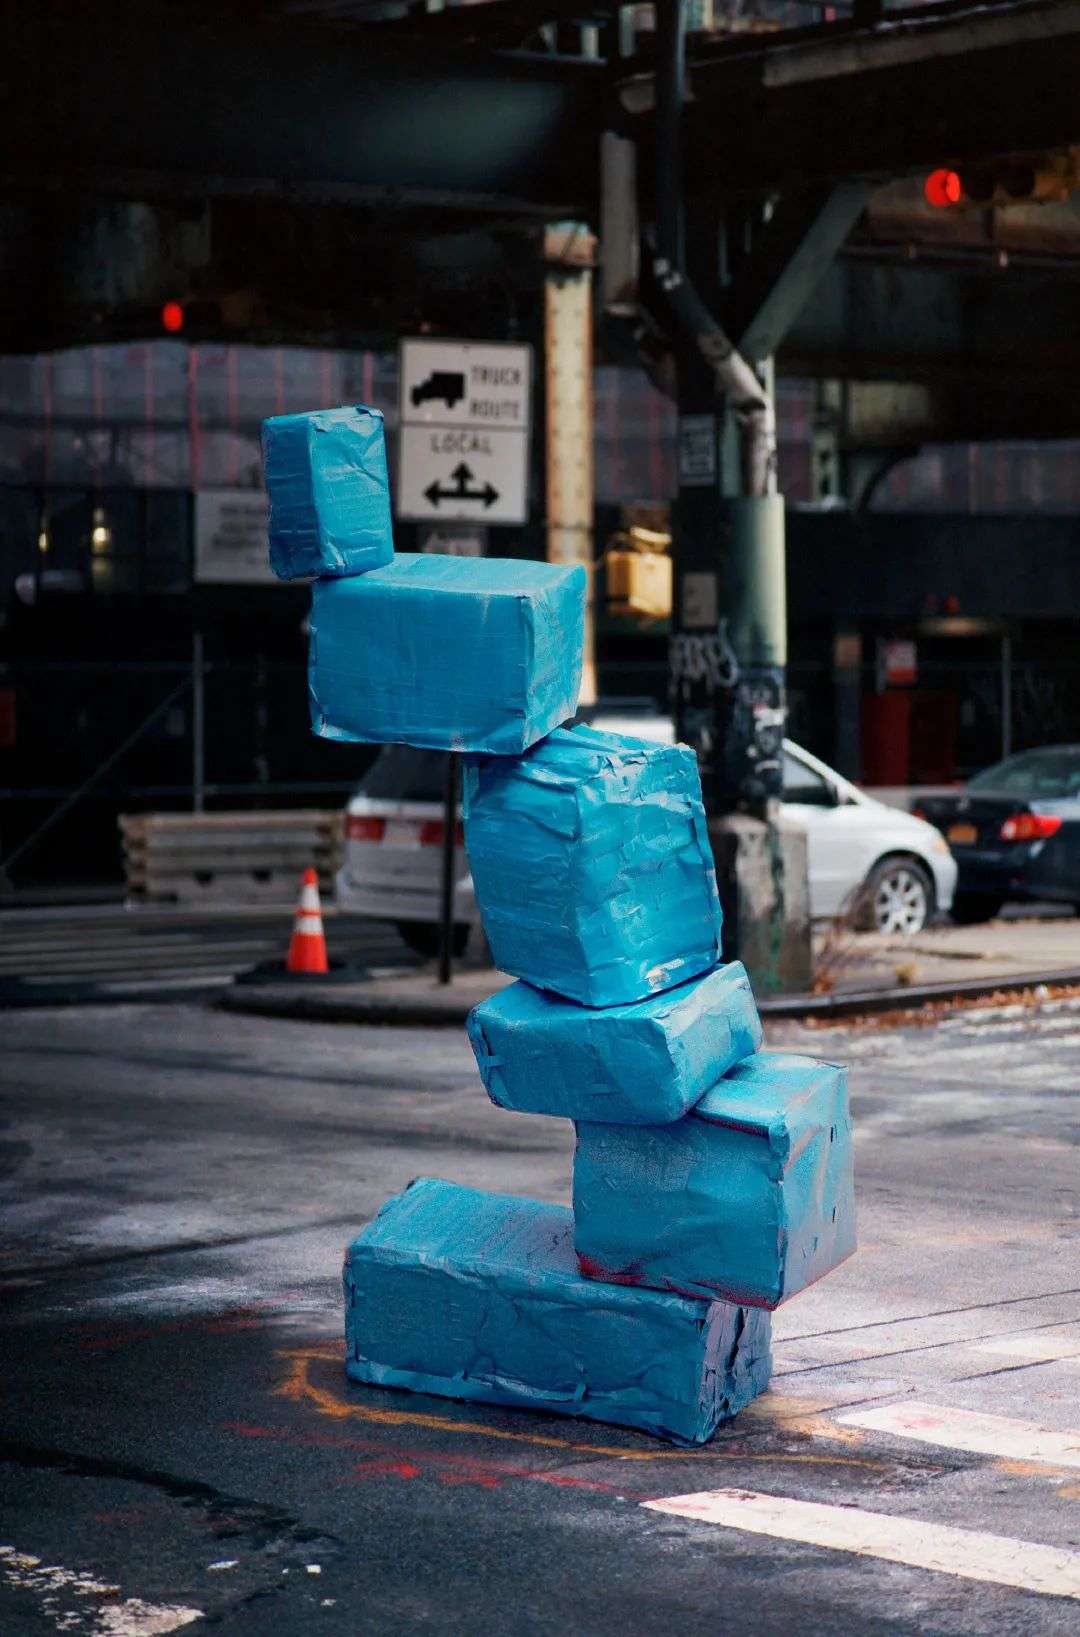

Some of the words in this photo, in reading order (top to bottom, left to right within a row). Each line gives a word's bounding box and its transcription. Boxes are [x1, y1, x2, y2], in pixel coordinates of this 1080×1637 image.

[472, 366, 521, 386] TRUCK
[470, 400, 520, 419] ROUTE
[431, 433, 492, 454] LOCAL
